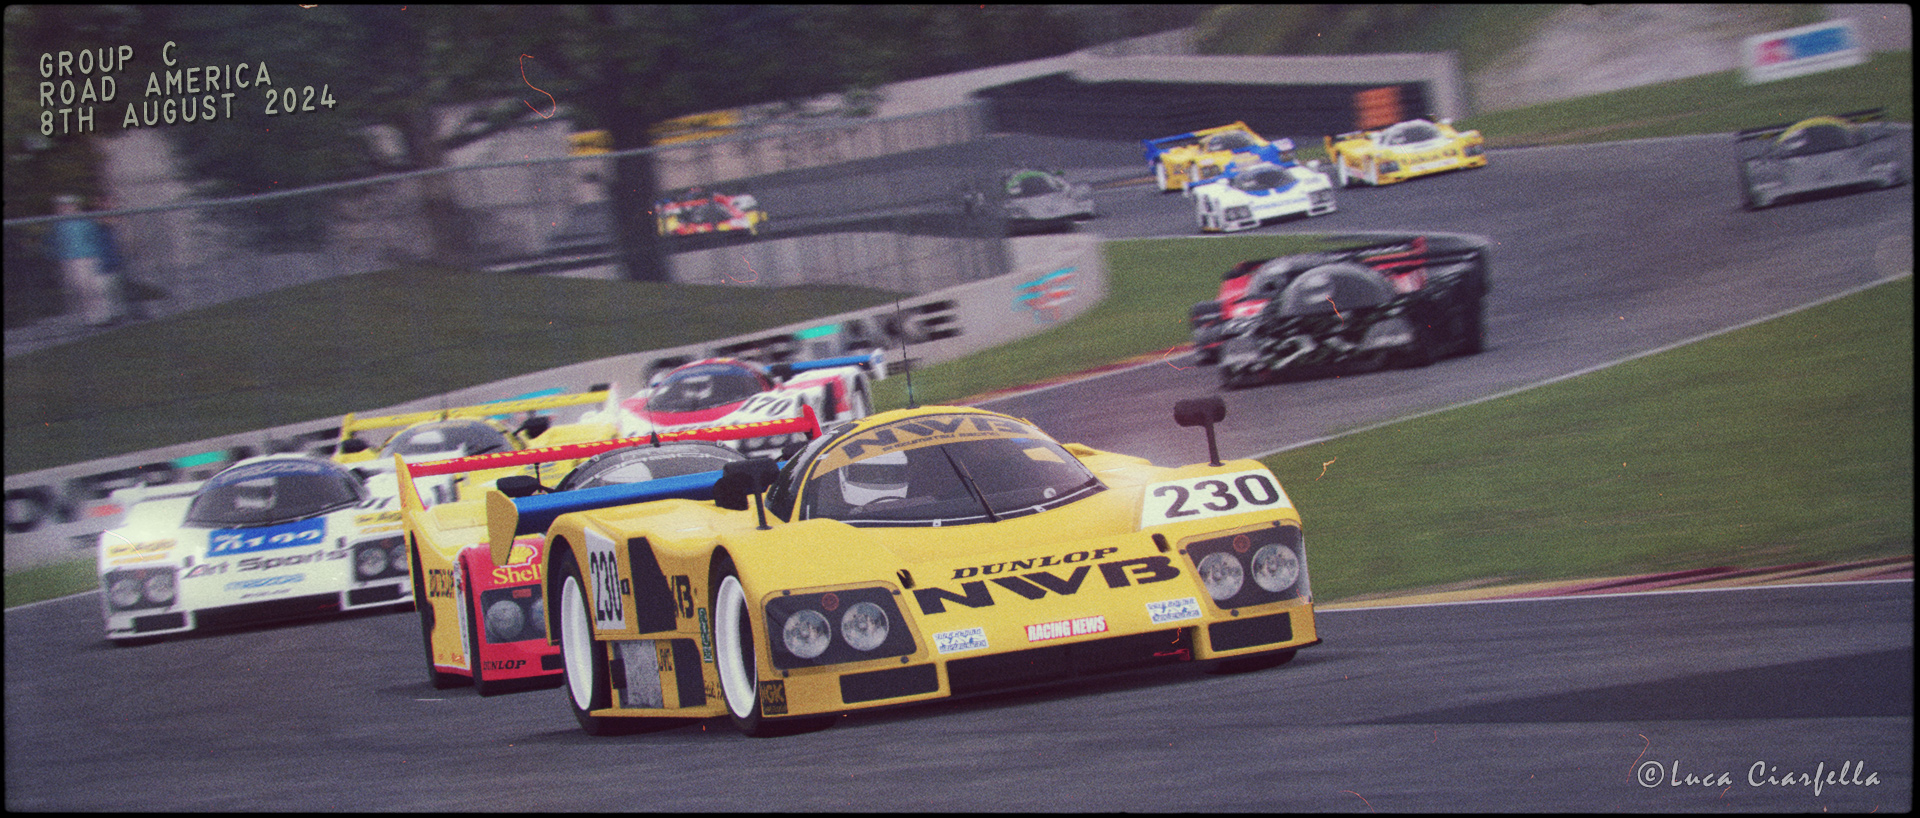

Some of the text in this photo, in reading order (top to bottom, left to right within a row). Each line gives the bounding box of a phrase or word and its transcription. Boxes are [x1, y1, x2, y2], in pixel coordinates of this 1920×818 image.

[841, 417, 1029, 459] NWB
[1152, 474, 1280, 519] 230
[237, 549, 348, 573] Sports
[952, 546, 1119, 580] DUNLOP
[590, 551, 623, 622] 230
[912, 555, 1181, 616] NWB
[1028, 616, 1107, 642] RACING NEWS
[483, 659, 527, 671] DUNLOP
